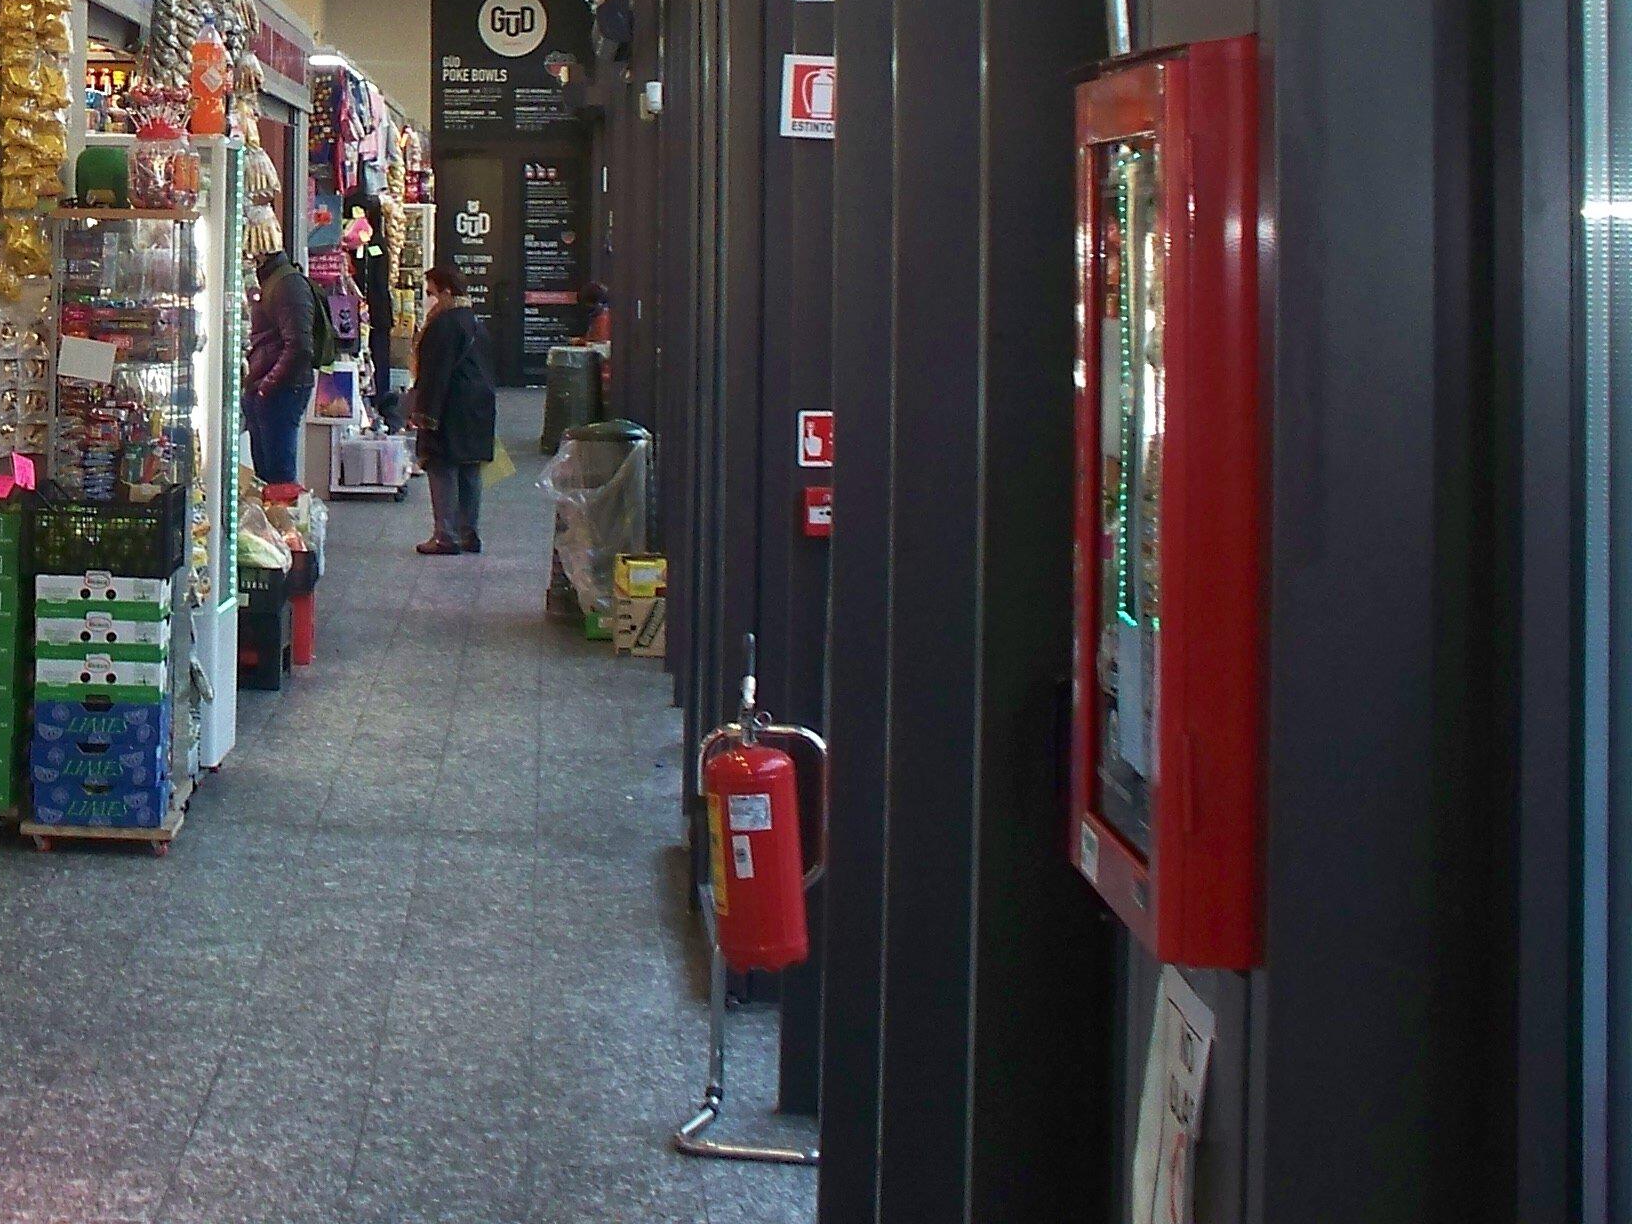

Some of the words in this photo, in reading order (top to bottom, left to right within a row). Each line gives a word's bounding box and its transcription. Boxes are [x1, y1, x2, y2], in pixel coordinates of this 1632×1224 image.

[442, 68, 470, 82] POKE
[471, 68, 508, 82] BOWLS
[791, 120, 834, 133] ESTINTO
[67, 717, 128, 733] LIMES
[62, 760, 123, 776] LIMES
[67, 801, 128, 817] LIMES
